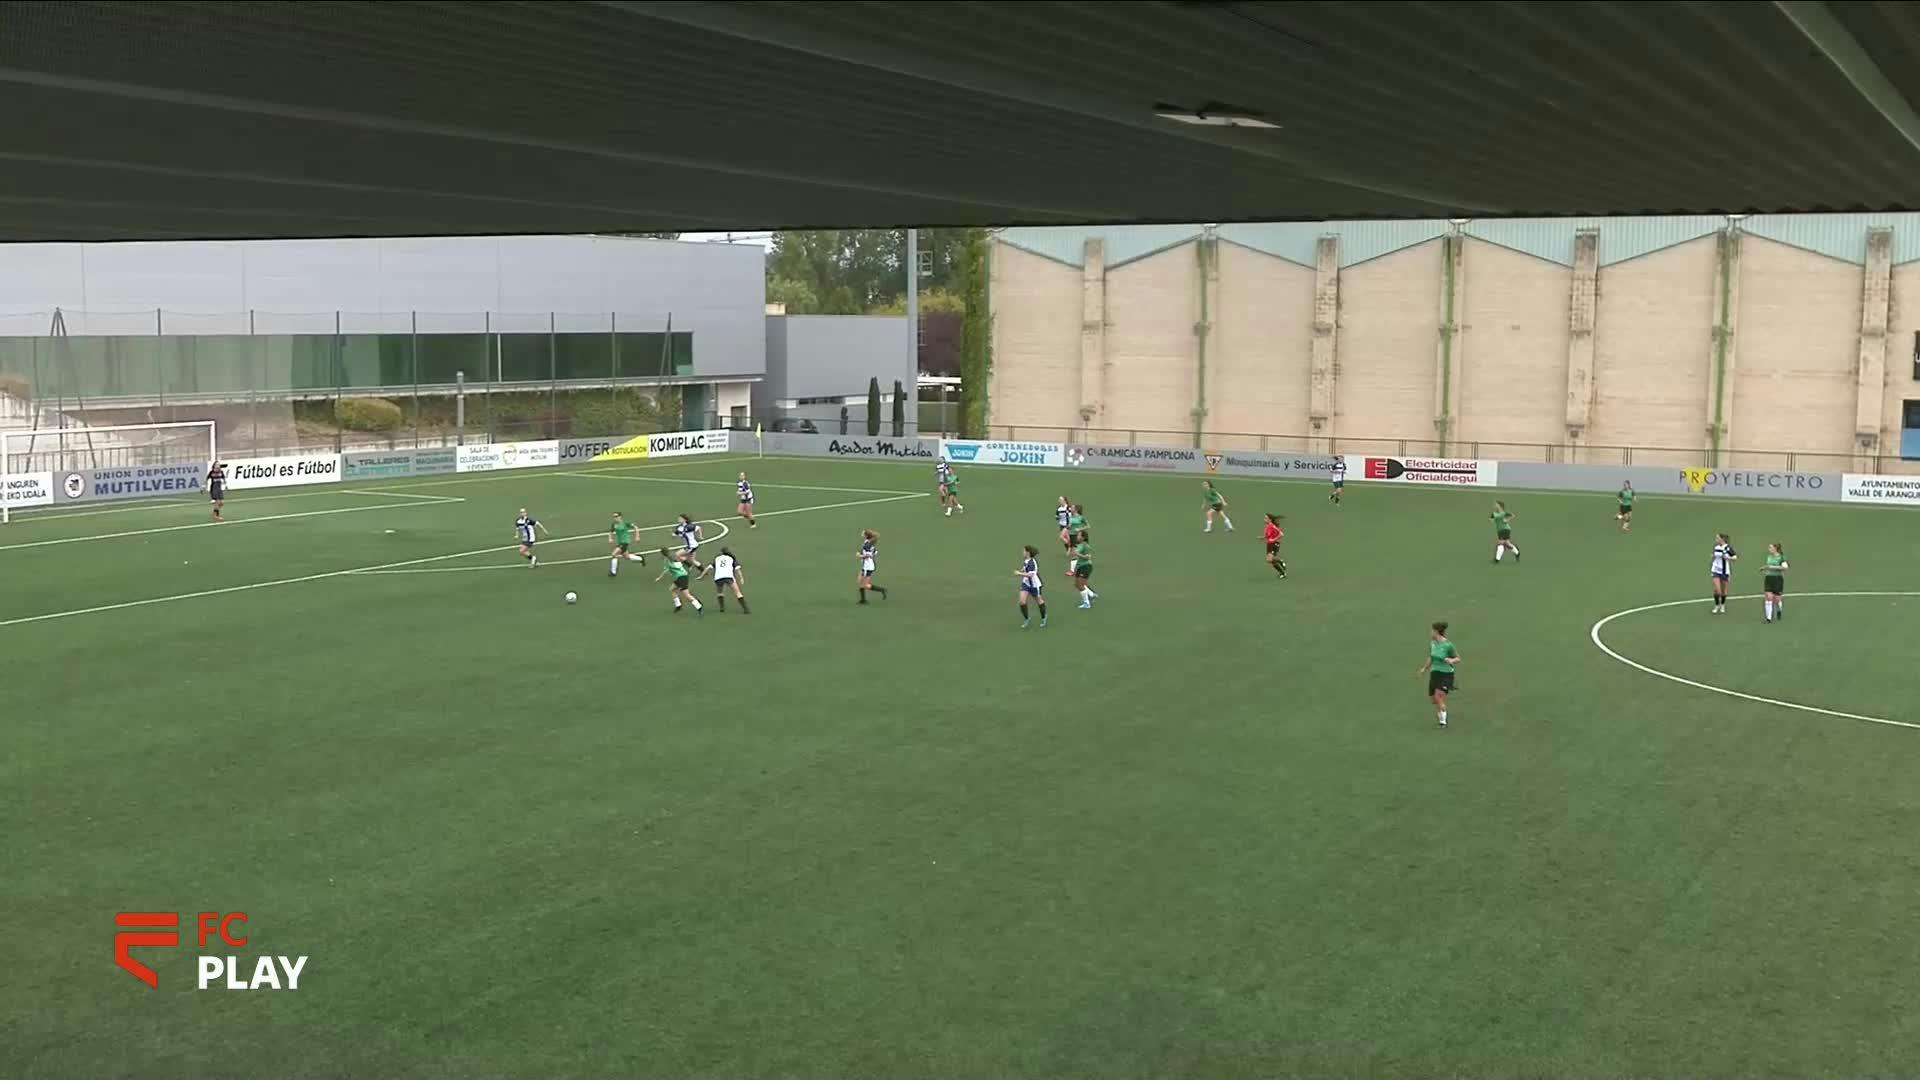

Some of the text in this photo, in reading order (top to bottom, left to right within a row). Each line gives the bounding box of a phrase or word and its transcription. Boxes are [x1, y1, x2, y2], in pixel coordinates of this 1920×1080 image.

[561, 443, 610, 458] JOYFER
[650, 434, 705, 452] KOMIPLAC
[829, 439, 874, 455] Asador
[1144, 450, 1195, 460] PAMPLONA
[137, 465, 200, 476] DEPORTIVA
[235, 463, 276, 479] Fútbol
[280, 465, 294, 476] es
[297, 460, 336, 475] Fútbol
[1405, 459, 1477, 469] Electricidad
[1405, 473, 1477, 483] Oficialdegui
[1680, 471, 1822, 489] PROYELECTRO
[95, 477, 200, 495] MUTILVERA
[1848, 488, 1870, 497] VALLE
